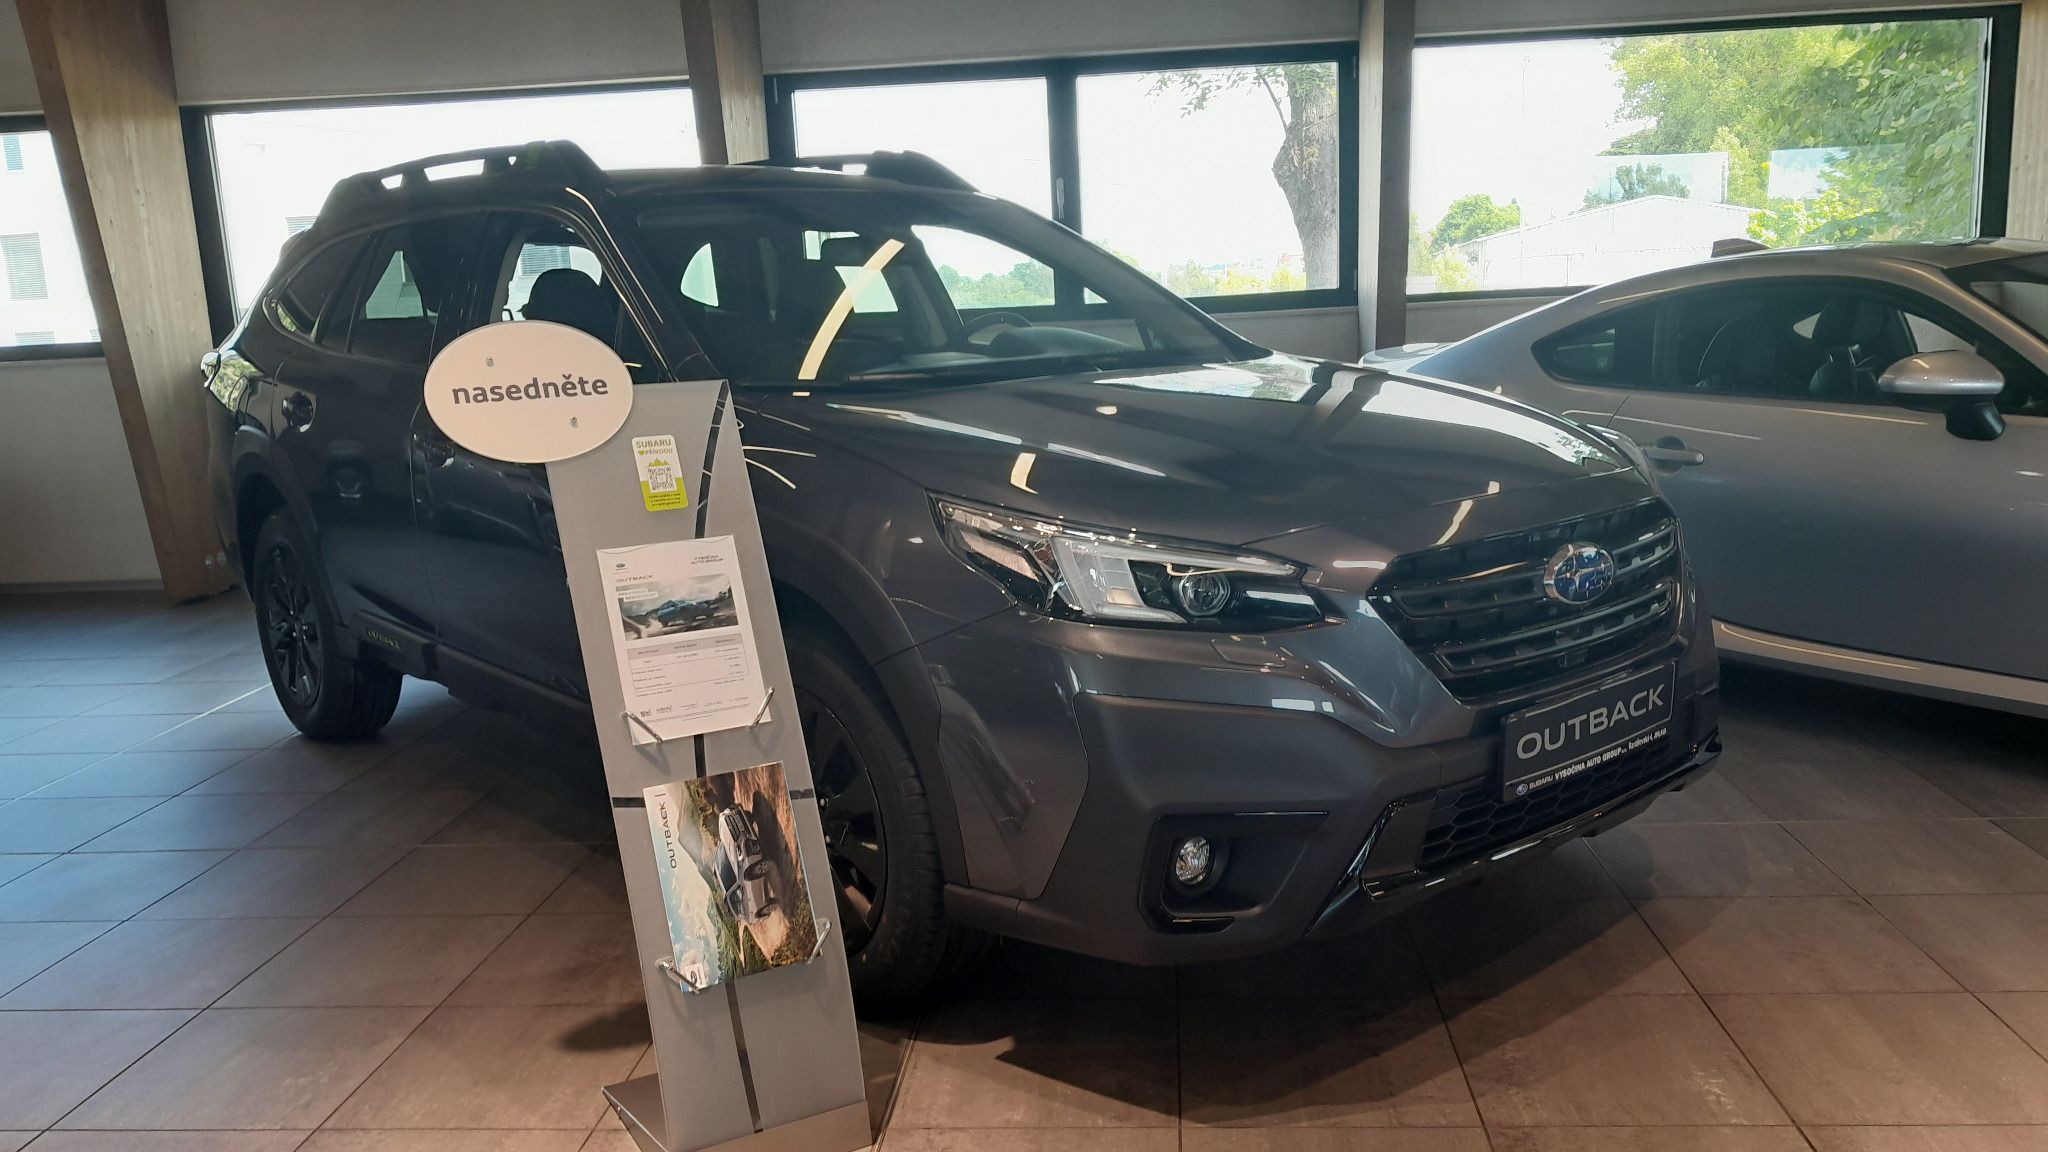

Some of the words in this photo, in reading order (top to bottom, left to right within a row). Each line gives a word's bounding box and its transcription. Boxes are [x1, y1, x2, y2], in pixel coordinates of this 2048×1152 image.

[452, 374, 609, 405] nasedněte
[636, 438, 672, 449] SUBARU
[616, 575, 653, 583] OUTBACK
[1516, 684, 1665, 760] OUTBACK
[1529, 775, 1554, 790] SUBARU
[1554, 762, 1586, 781] VYSOČINA
[1586, 755, 1602, 769] AUTO
[659, 801, 677, 869] OUTBACK
